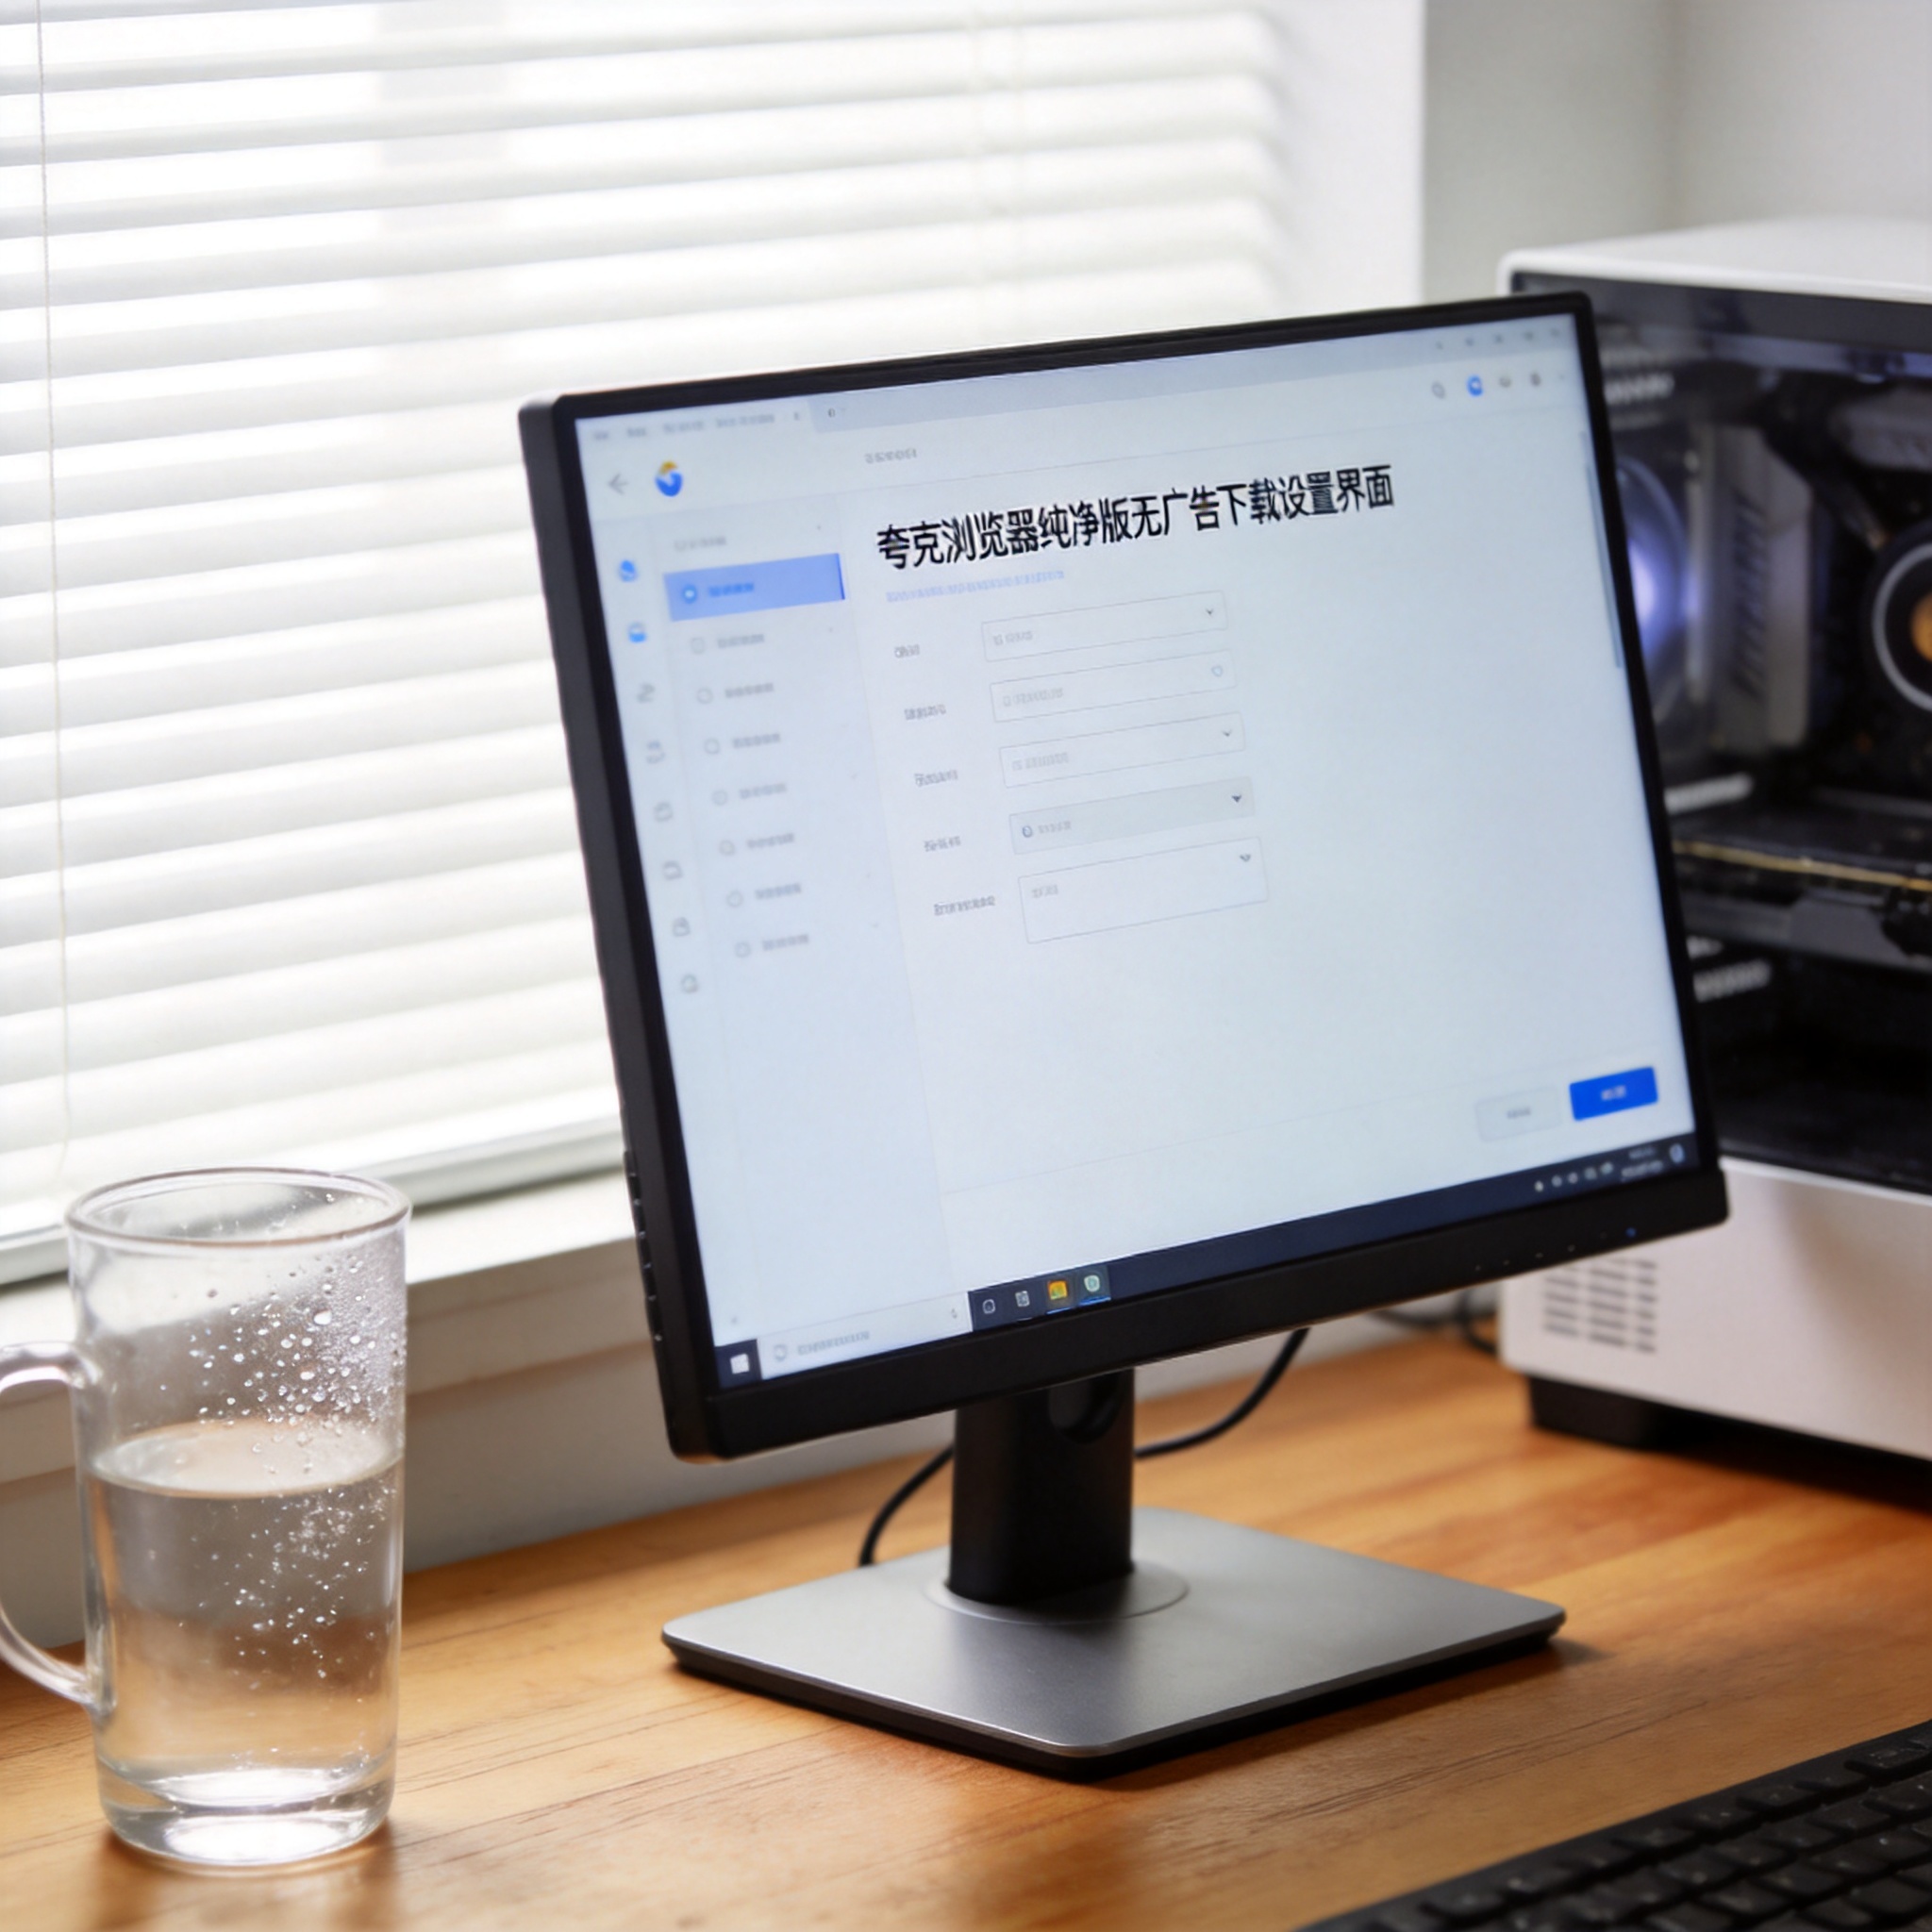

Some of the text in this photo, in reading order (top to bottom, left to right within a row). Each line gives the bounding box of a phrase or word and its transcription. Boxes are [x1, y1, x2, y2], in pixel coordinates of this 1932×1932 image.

[877, 464, 1393, 569] 夸克浏览器纯净版无广告下载设置界面
